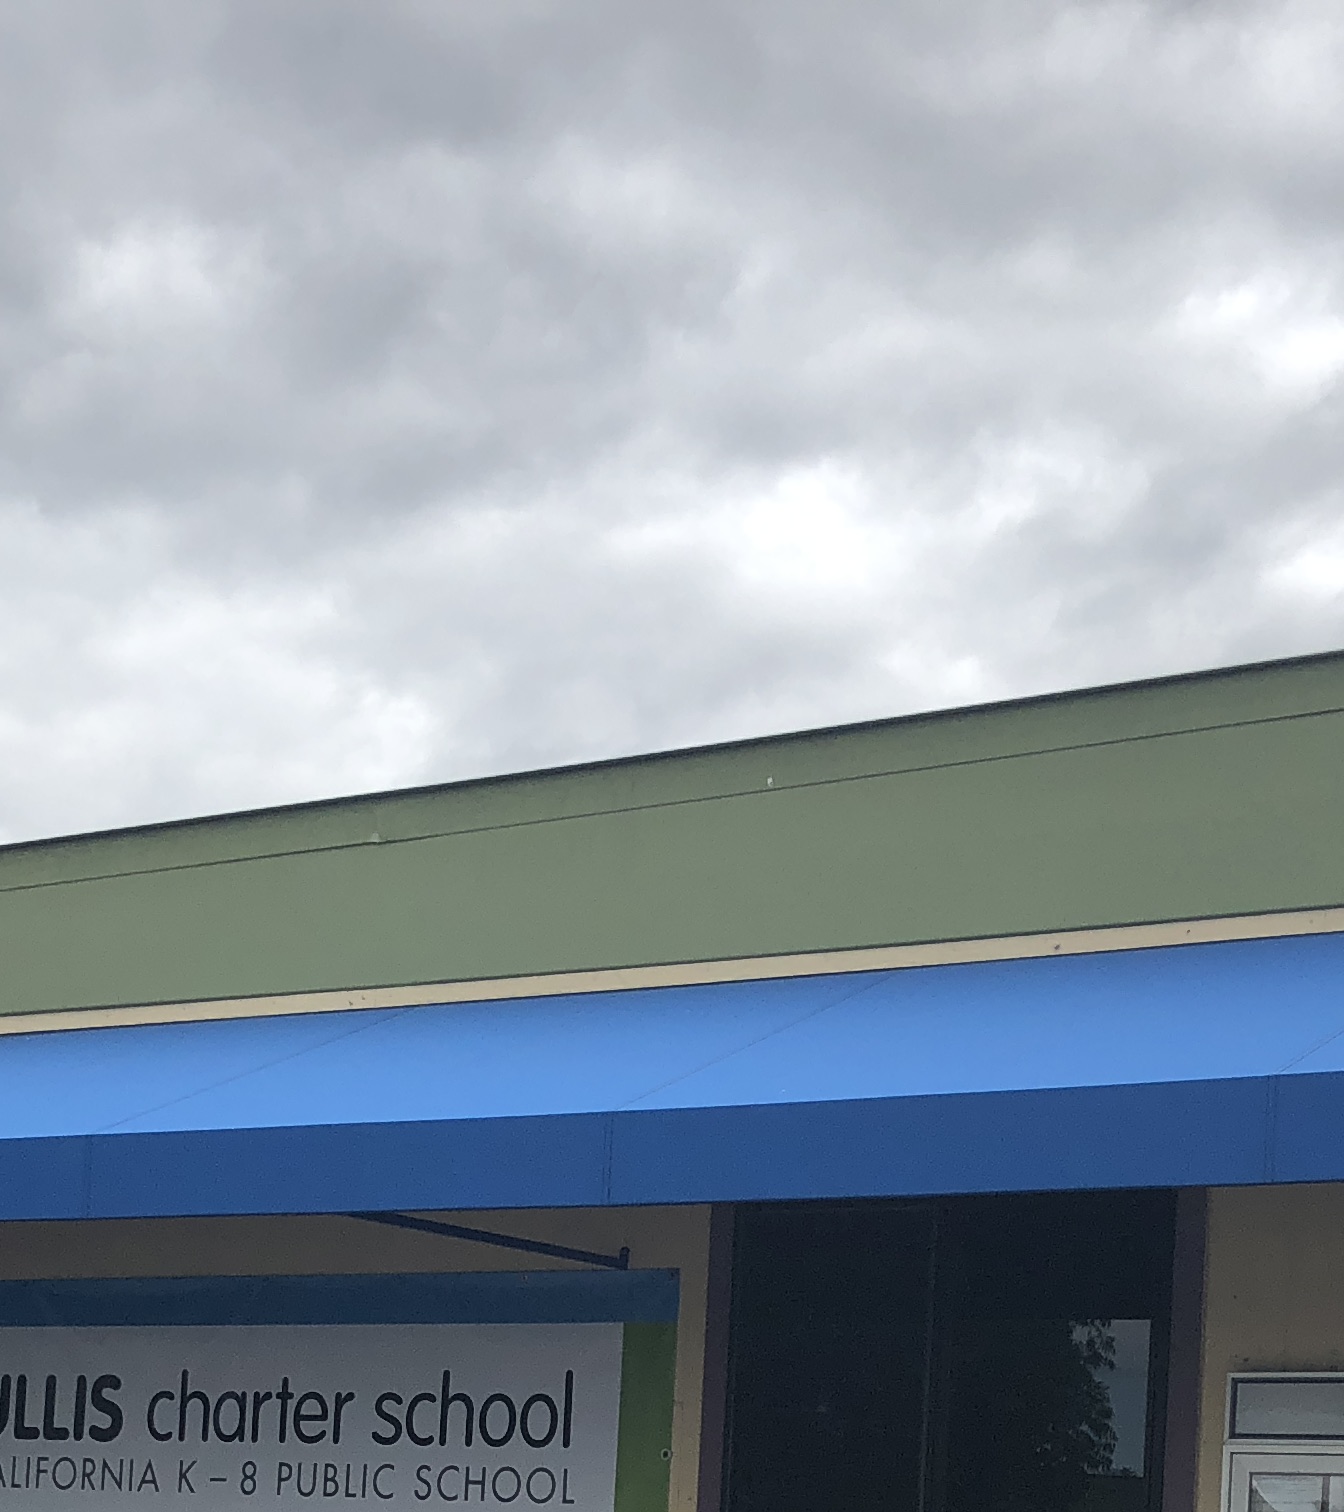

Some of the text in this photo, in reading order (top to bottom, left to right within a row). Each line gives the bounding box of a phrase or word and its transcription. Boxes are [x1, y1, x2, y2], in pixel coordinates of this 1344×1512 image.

[146, 1369, 355, 1444] charter
[371, 1369, 574, 1449] school
[177, 1459, 197, 1494] K
[239, 1460, 257, 1496] 8
[276, 1461, 395, 1499] PUBLIC
[413, 1465, 575, 1504] SCHOOL
